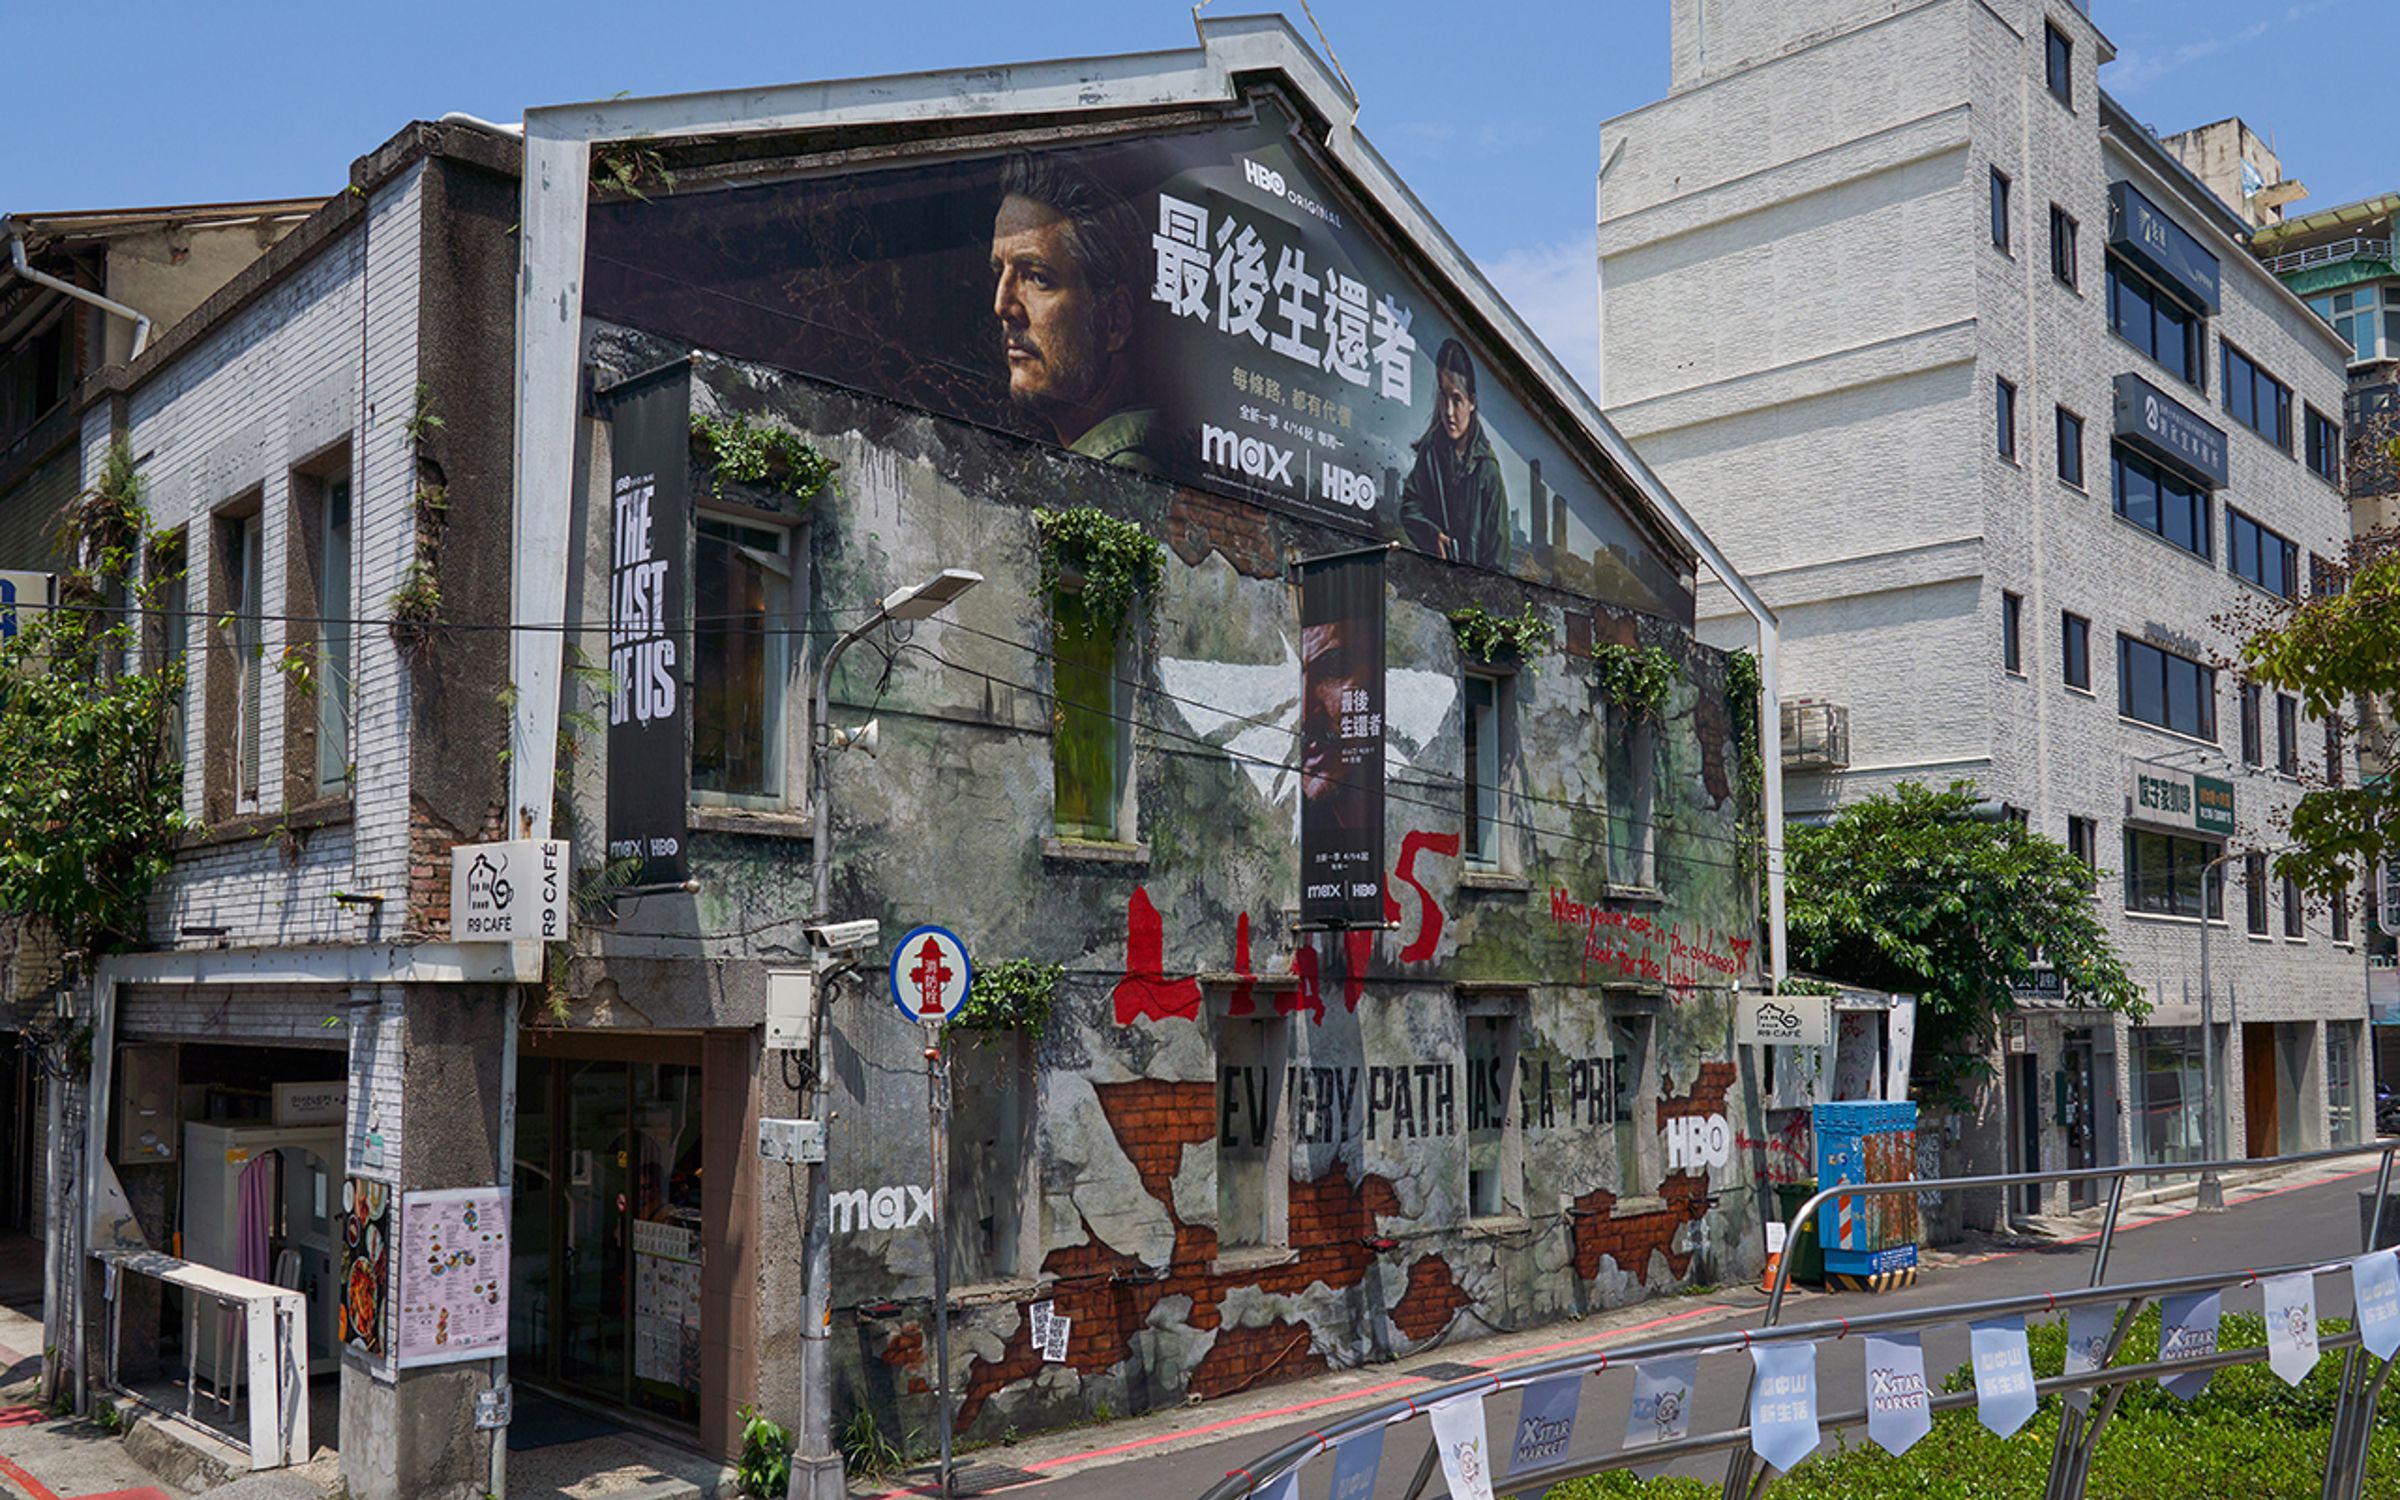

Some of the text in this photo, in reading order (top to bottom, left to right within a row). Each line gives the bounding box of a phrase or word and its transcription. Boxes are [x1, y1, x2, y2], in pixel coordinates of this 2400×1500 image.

[1244, 158, 1342, 229] HBO ORIGINAL
[1151, 193, 1416, 407] 最後生還者
[1202, 423, 1294, 487] max
[1322, 462, 1376, 511] HBO
[615, 485, 655, 569] THE
[612, 560, 668, 646] LAST
[611, 639, 676, 726] OF US
[611, 837, 678, 858] max HBO
[467, 913, 512, 933] R9 CAFÉ
[541, 842, 558, 937] R9 CAFÉ
[1307, 884, 1377, 899] max HBO
[1551, 886, 1586, 928] When
[1669, 922, 1688, 959] the
[924, 959, 938, 1004] 消防栓
[1757, 1029, 1771, 1038] R9
[1367, 1064, 1454, 1141] PATH
[1667, 1114, 1730, 1177] HBO
[830, 1186, 934, 1234] max
[1874, 1391, 1925, 1413] MARKET
[1516, 1438, 1567, 1463] MARKET
